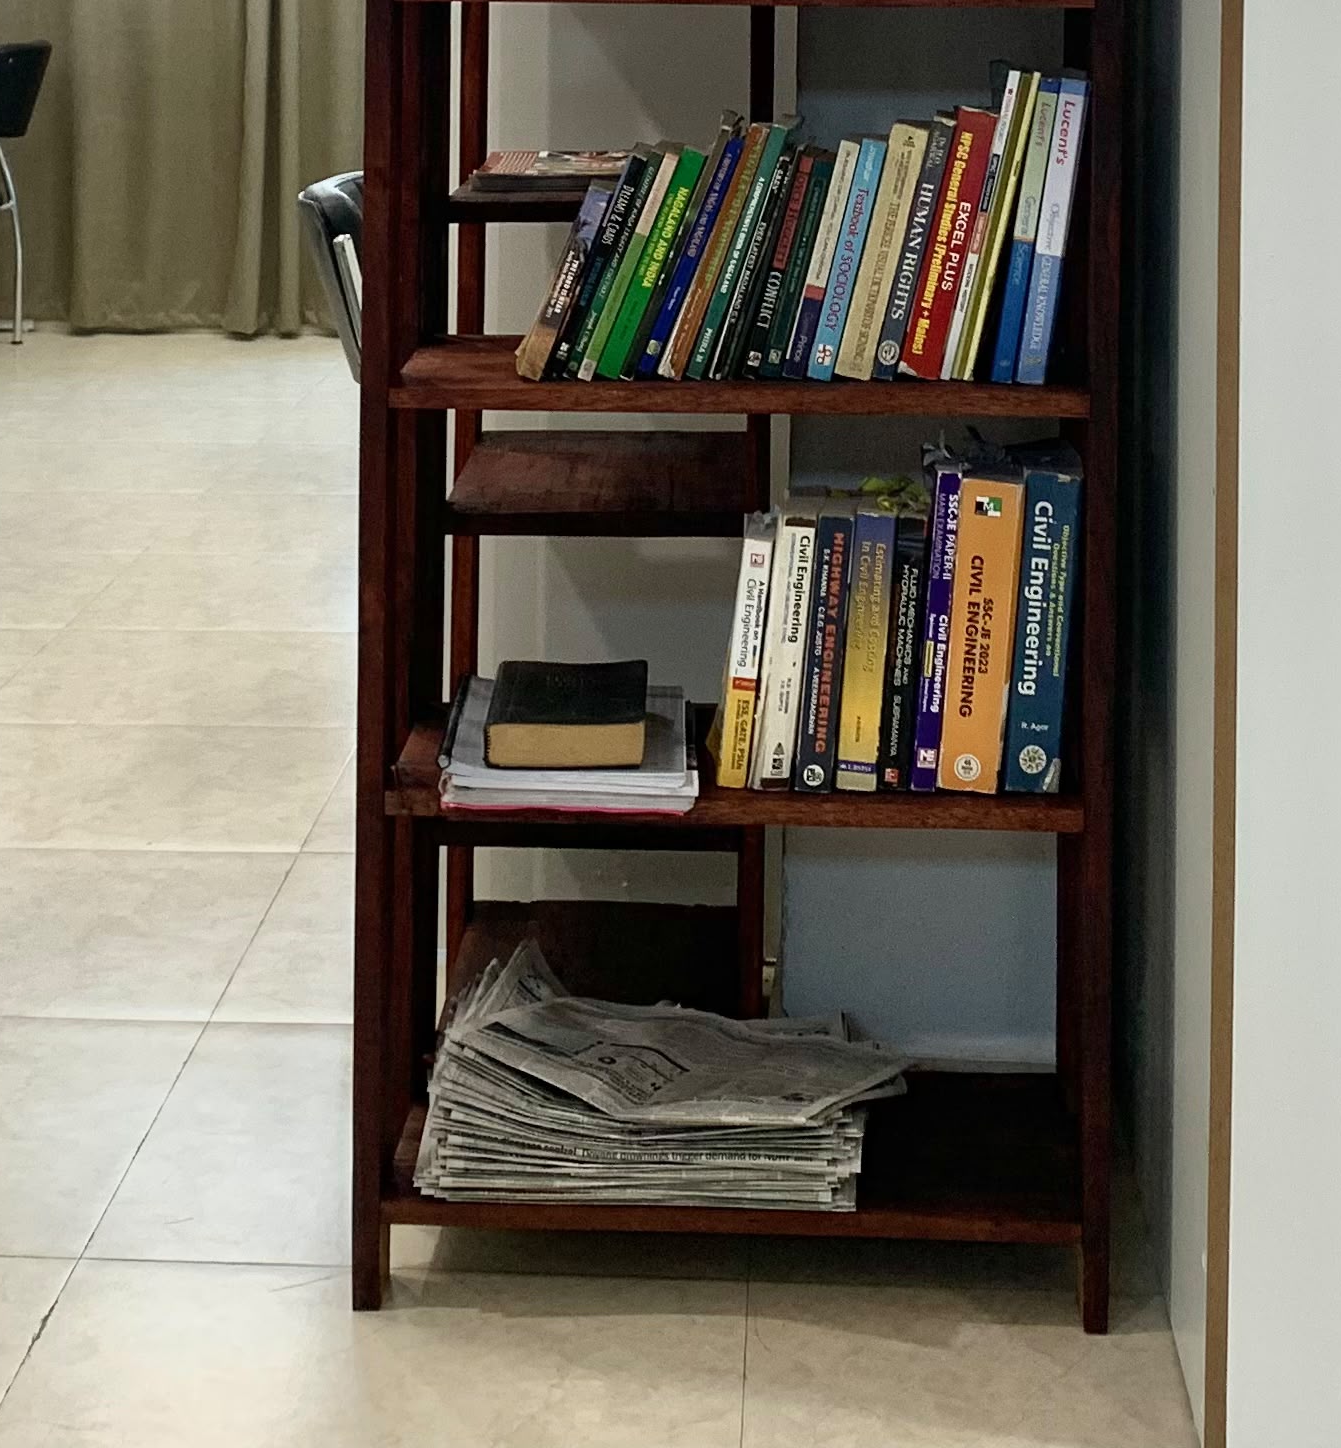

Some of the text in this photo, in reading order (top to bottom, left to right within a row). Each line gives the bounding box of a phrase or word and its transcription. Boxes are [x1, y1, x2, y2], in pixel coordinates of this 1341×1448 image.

[1054, 100, 1075, 166] Lucent's
[612, 183, 635, 216] DREAMS
[846, 187, 868, 236] Textbook
[946, 159, 965, 203] General
[600, 221, 620, 247] CHAOS
[660, 186, 688, 238] NAGALAND
[937, 203, 956, 242] Studies
[641, 260, 659, 288] INDIA
[652, 238, 668, 260] AND
[890, 182, 935, 321] HUMAN RIGHTS
[940, 201, 970, 291] EXCEL PLUS
[755, 270, 781, 329] CONFLICT
[823, 254, 852, 332] SOCIOLOGY
[858, 554, 871, 579] Civil
[931, 493, 946, 579] MAIN EXAMINATION
[941, 494, 958, 580] SSC-JE PAPER-II
[1060, 524, 1070, 569] Objective
[744, 578, 756, 602] Civil
[787, 535, 810, 644] Civil Engineering
[869, 542, 886, 603] Estimating
[908, 568, 917, 598] FLUID
[1049, 543, 1060, 591] Questions
[753, 587, 764, 628] Handbook
[869, 604, 880, 627] and
[892, 564, 910, 686] HYDRAULIC MACHINES
[1016, 500, 1057, 696] Civil Engineering
[1044, 600, 1055, 642] Answers
[736, 603, 754, 667] Engineering
[813, 532, 844, 753] HIGHWAY ENGINEERING
[902, 600, 915, 665] MECHANICS
[929, 614, 948, 712] Civil Engineering
[957, 555, 984, 718] CIVIL ENGINEERING
[977, 597, 993, 674] SSC-JE 2023
[1052, 615, 1064, 677] Conventional
[888, 694, 901, 756] SUBRAMANYA
